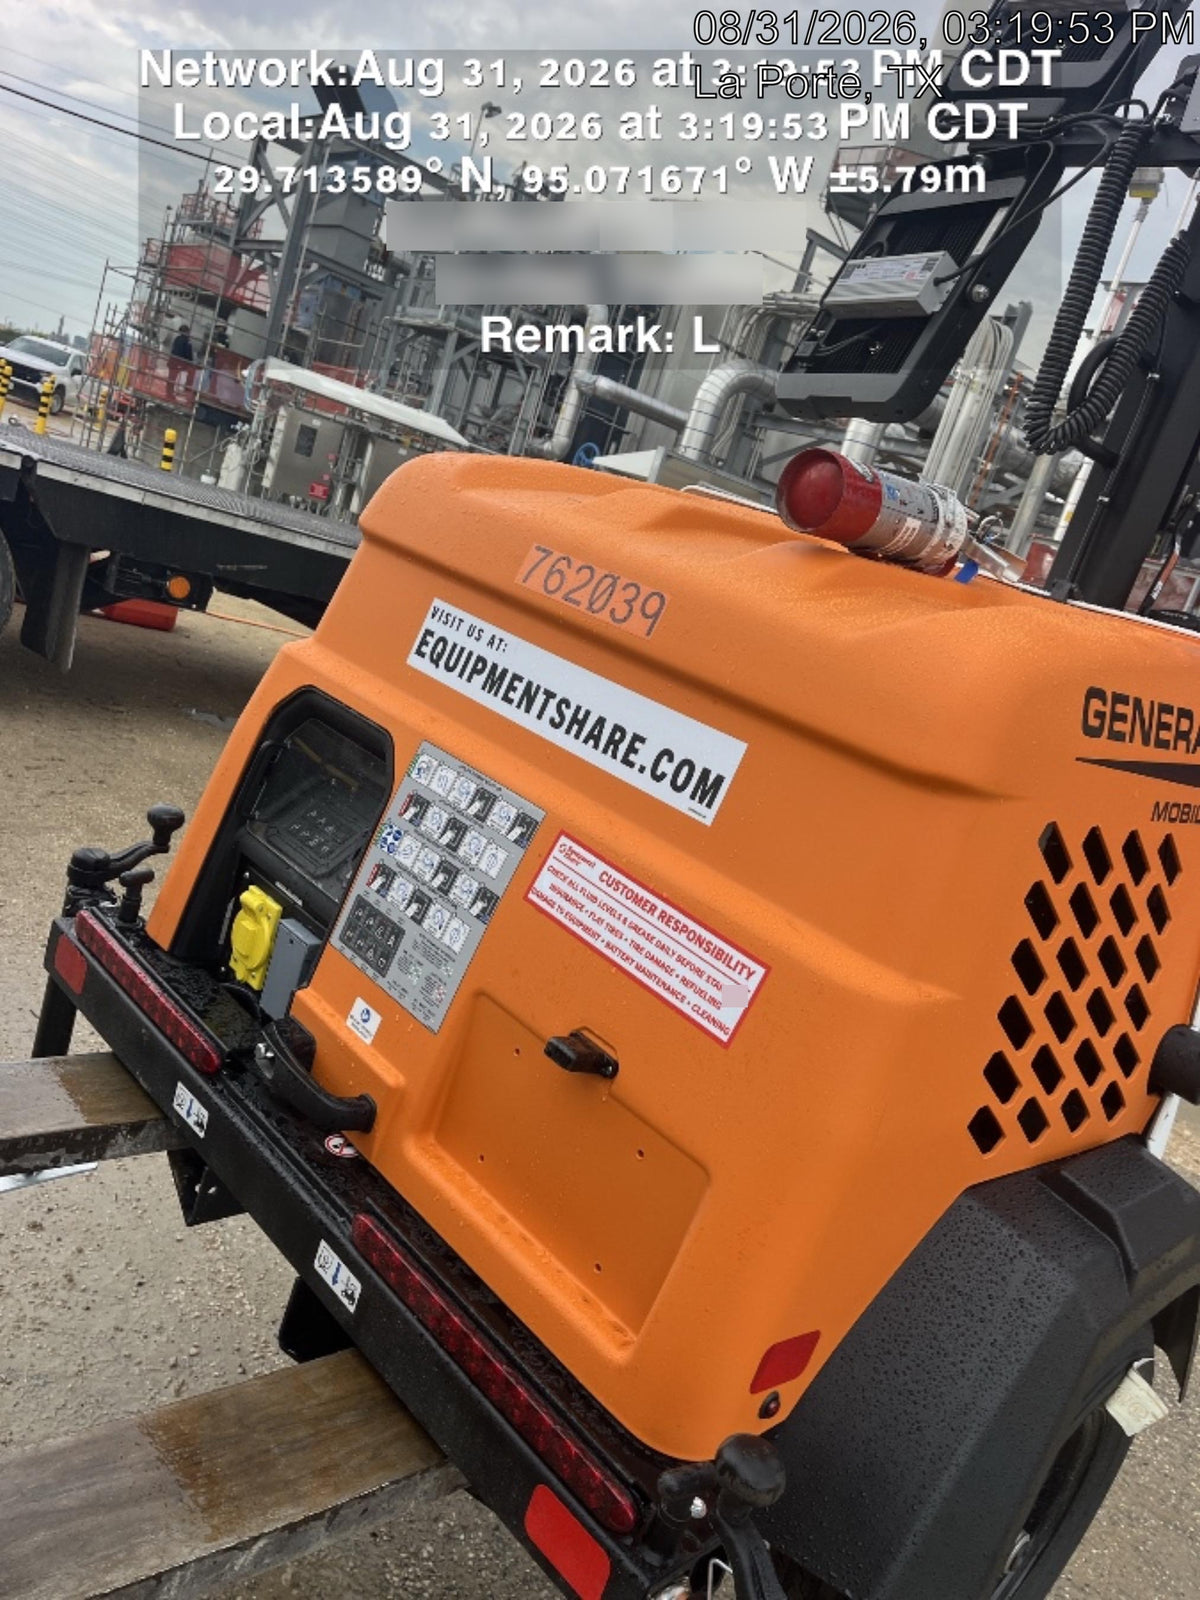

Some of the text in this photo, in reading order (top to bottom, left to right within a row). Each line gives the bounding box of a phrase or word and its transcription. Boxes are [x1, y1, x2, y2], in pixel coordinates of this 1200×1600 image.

[430, 605, 509, 653] VISIT US AT:
[521, 545, 667, 636] 762039
[413, 628, 725, 810] EQUIPMENTSHARE.COM
[547, 865, 568, 883] CHECK
[567, 879, 579, 891] ALL
[579, 887, 597, 903] FLUID
[597, 899, 622, 920] LEVELS
[627, 920, 654, 943] GREASE
[655, 939, 675, 957] DAILY
[676, 954, 705, 978] BEFORE
[555, 905, 564, 915] TO
[564, 911, 600, 941] EQUIPMENT
[604, 940, 634, 965] BATTERY
[634, 962, 685, 1003] MAINTENANCE
[691, 1003, 730, 1035] CLEANING
[588, 911, 604, 926] FLAT
[604, 922, 623, 939] TIRES
[629, 939, 644, 954] TIRE
[644, 950, 674, 975] DAMAGE
[680, 975, 721, 1009] REFUELING
[599, 871, 754, 980] CUSTOMER RESPONSIBILITY
